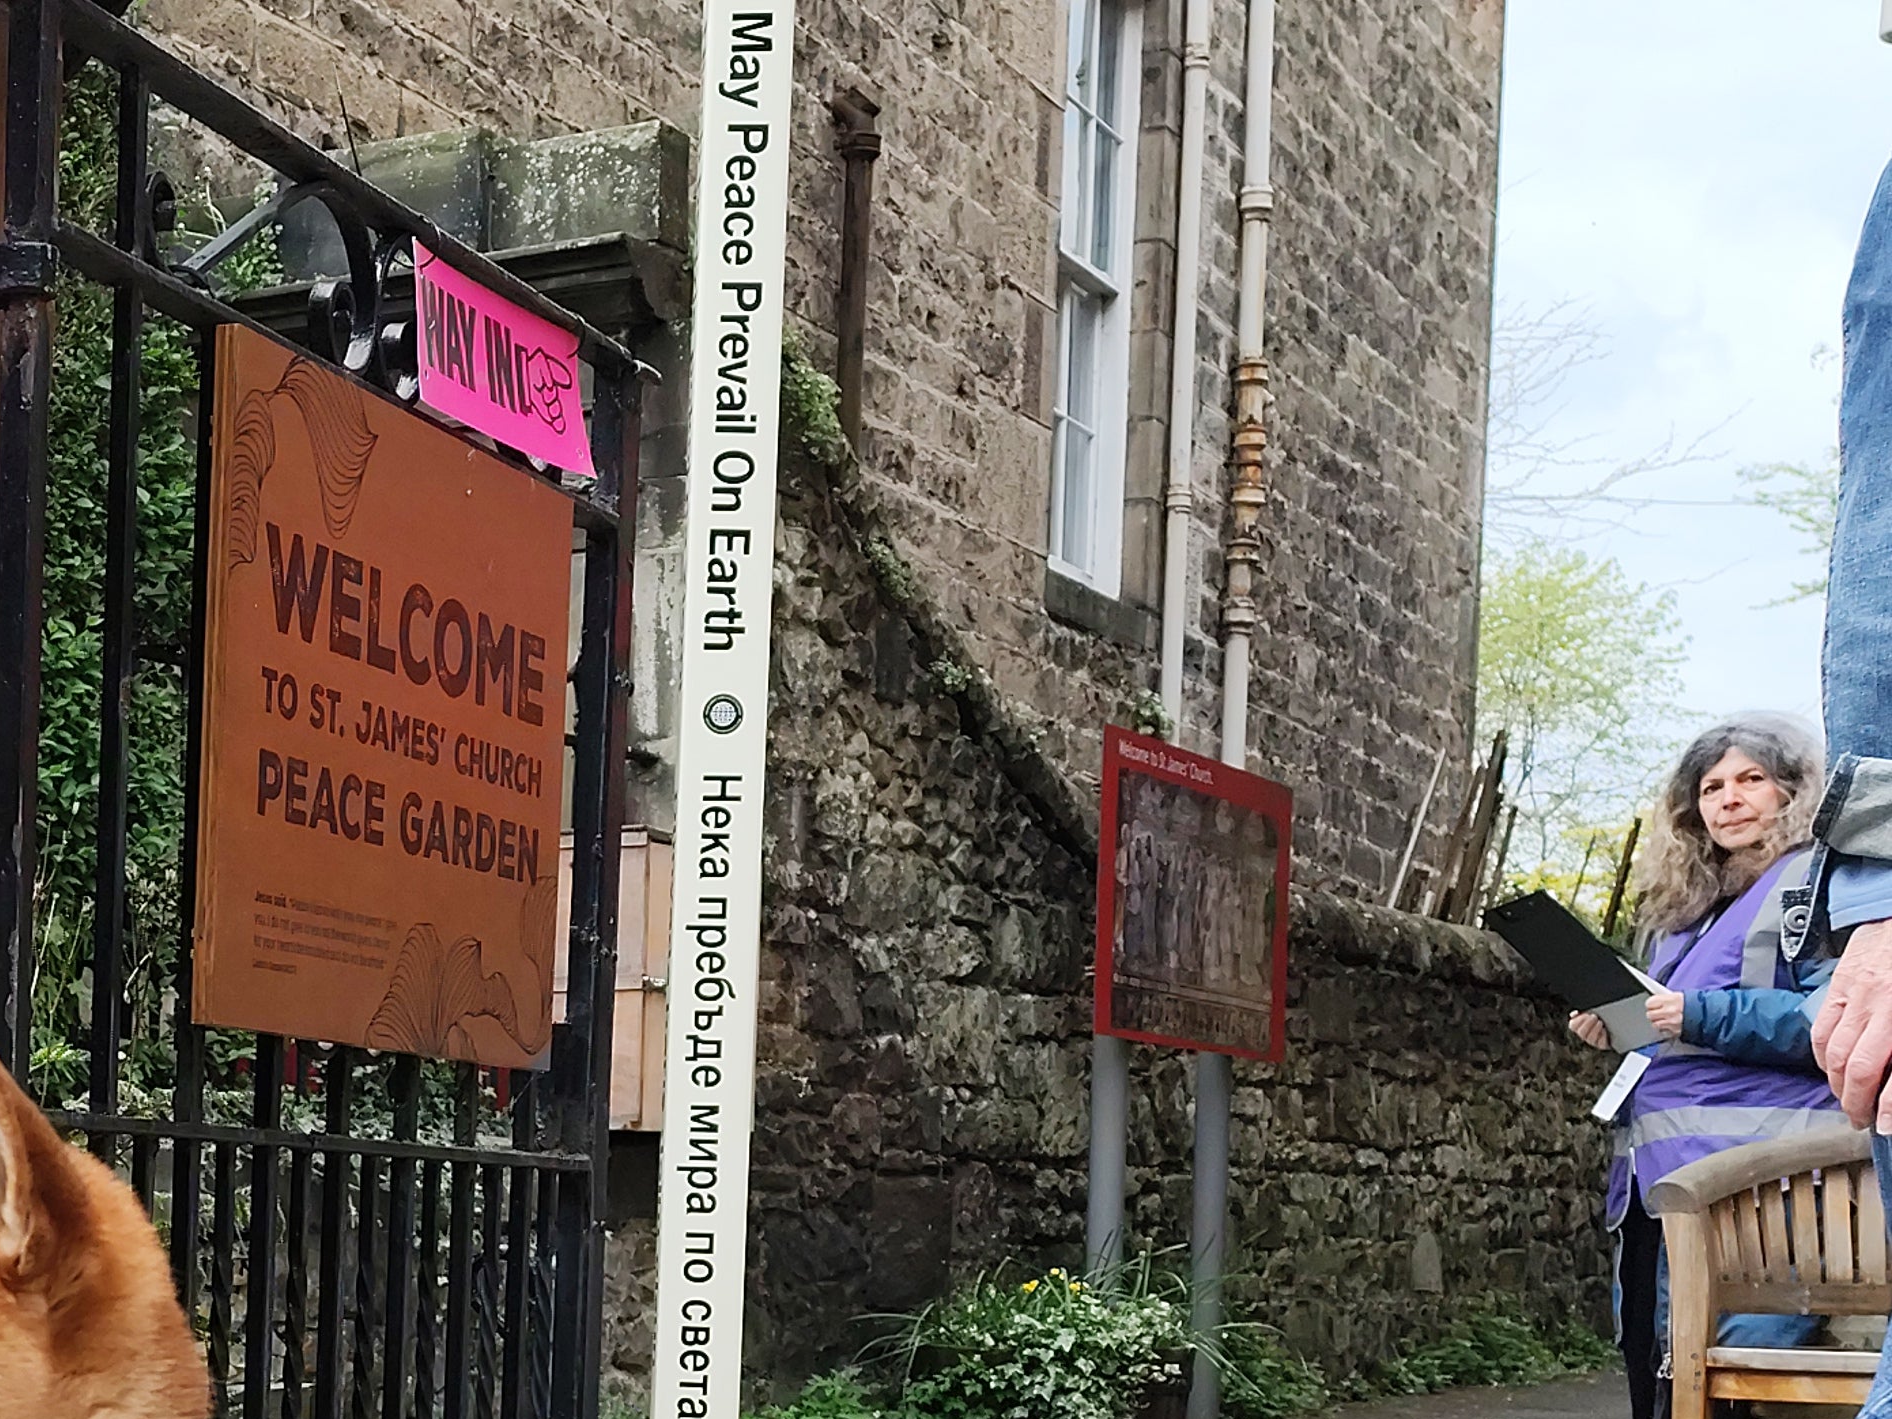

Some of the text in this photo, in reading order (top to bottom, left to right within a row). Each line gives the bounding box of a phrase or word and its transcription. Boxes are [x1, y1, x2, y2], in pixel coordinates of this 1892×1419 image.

[421, 272, 517, 414] WAY IN
[703, 12, 774, 652] May Peace Prevail On Earth
[265, 521, 546, 728] WELCOME
[256, 748, 540, 886] PEACE GARDEN
[261, 666, 542, 799] TO ST. JAMES' CHURCH
[677, 774, 743, 1419] Нека пребъде мира по света
